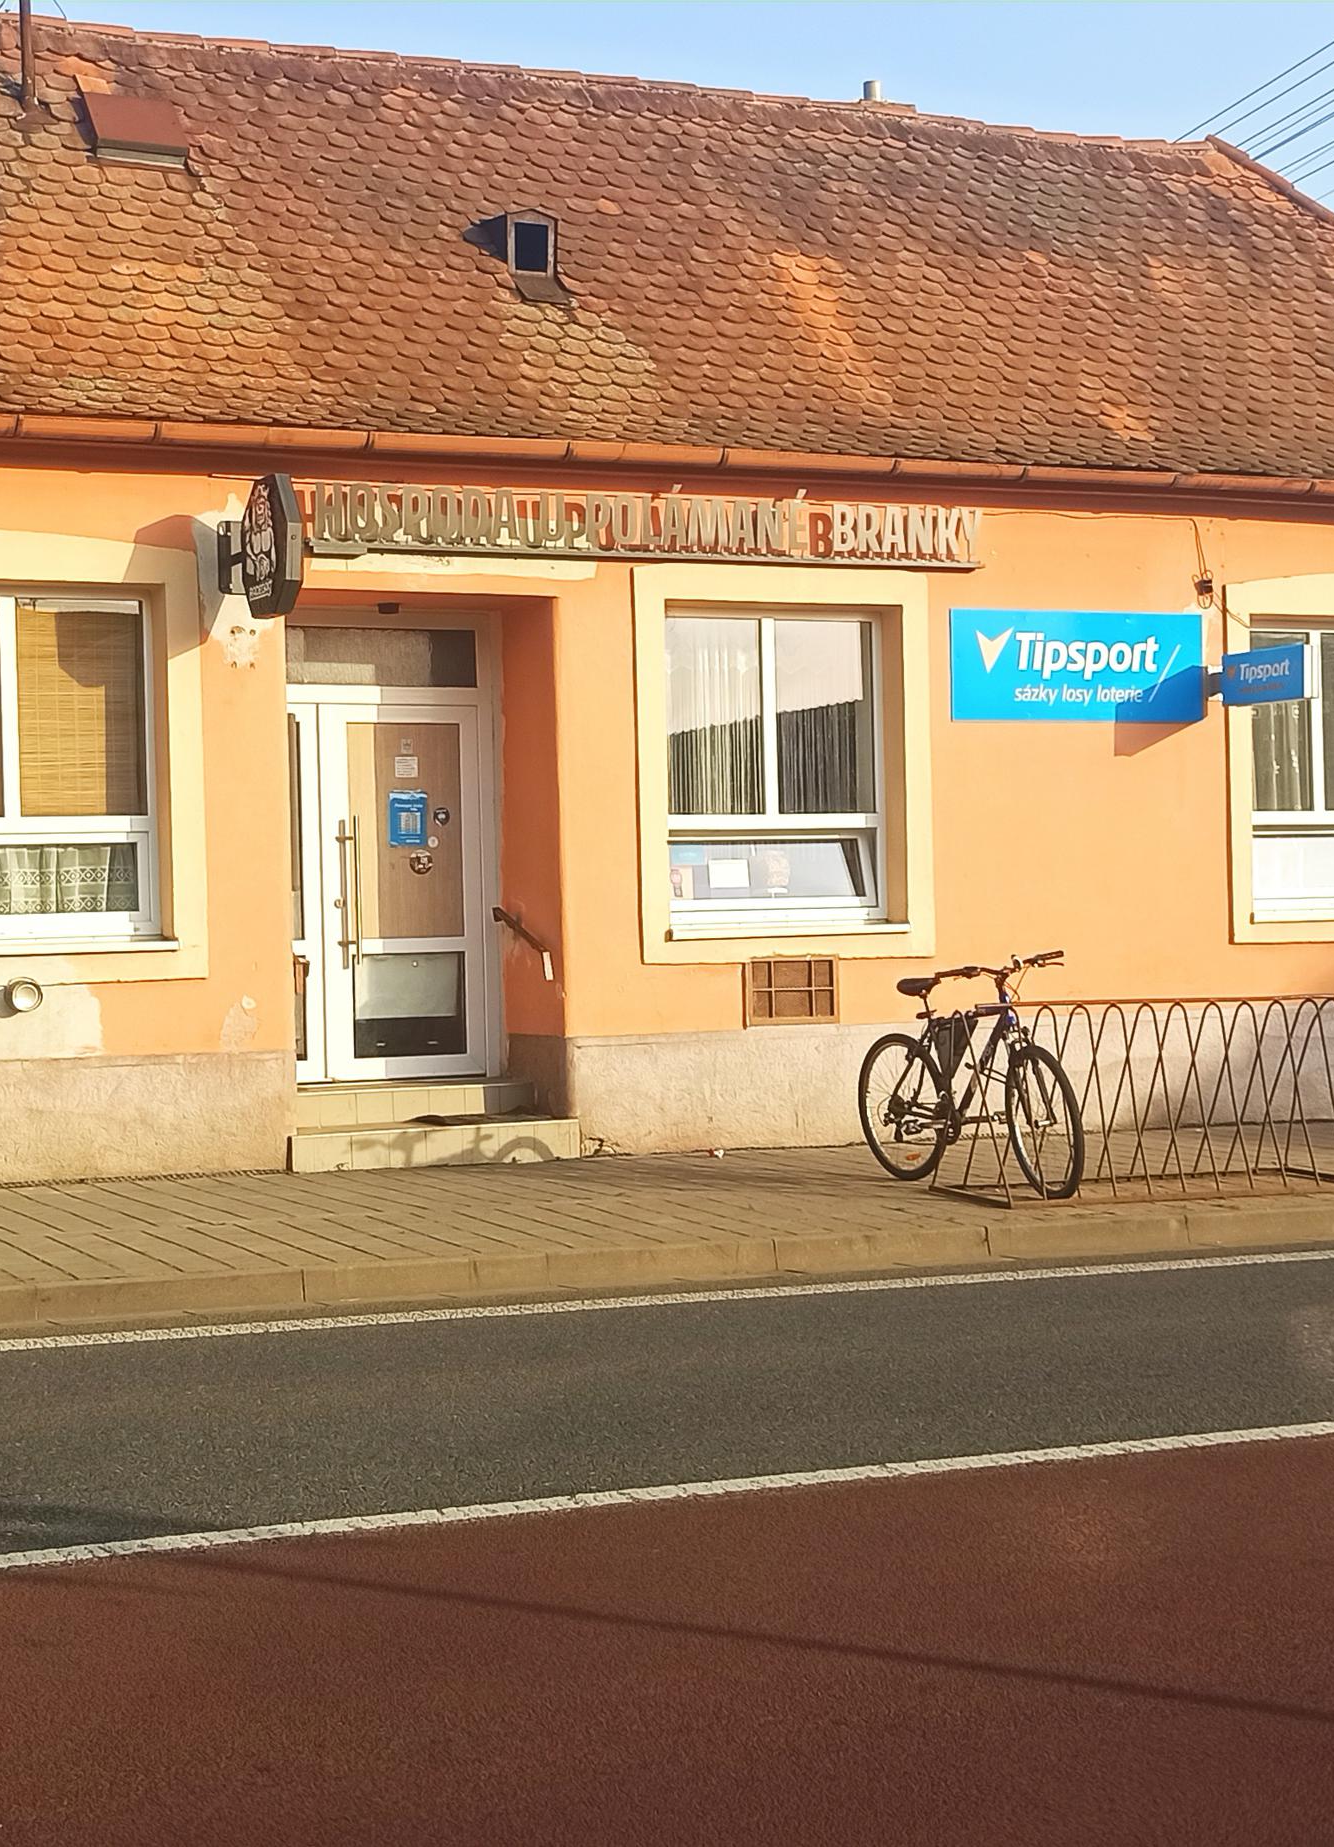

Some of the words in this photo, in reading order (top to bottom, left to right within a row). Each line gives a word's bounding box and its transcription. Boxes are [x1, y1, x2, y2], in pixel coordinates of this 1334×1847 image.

[315, 481, 517, 546] HOSPODA
[538, 491, 566, 541] U
[585, 483, 809, 551] POLÁMANÉ
[833, 503, 983, 555] BRANKY
[1014, 631, 1160, 681] Tipsport
[1239, 658, 1291, 684] Tipsport
[1013, 683, 1058, 706] sázky
[1061, 683, 1094, 706] losy
[1096, 684, 1144, 703] loterie
